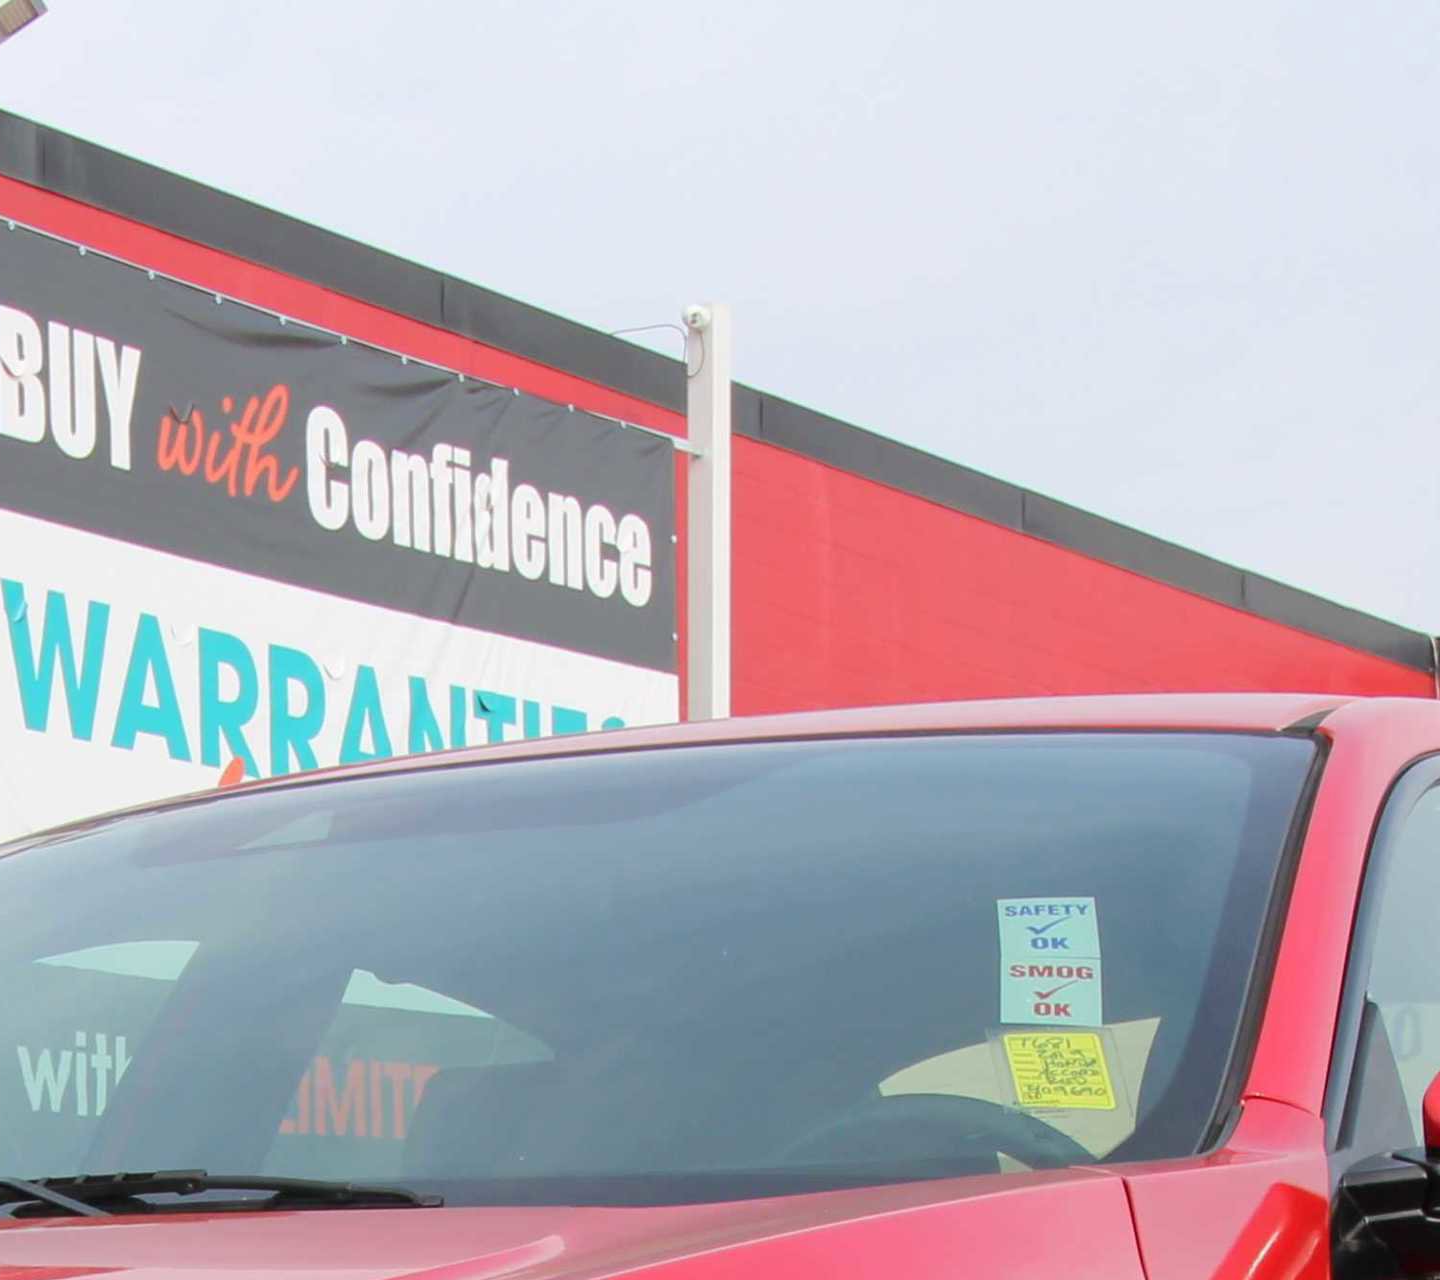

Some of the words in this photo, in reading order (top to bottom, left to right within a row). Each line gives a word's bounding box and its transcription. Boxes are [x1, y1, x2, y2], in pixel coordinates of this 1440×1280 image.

[156, 384, 297, 502] with
[305, 405, 652, 607] Confidence
[0, 577, 625, 779] WARRANT
[1005, 904, 1088, 917] SAFETY
[1031, 937, 1070, 949] OK
[1010, 965, 1093, 979] SMOG
[1034, 1003, 1072, 1017] OK
